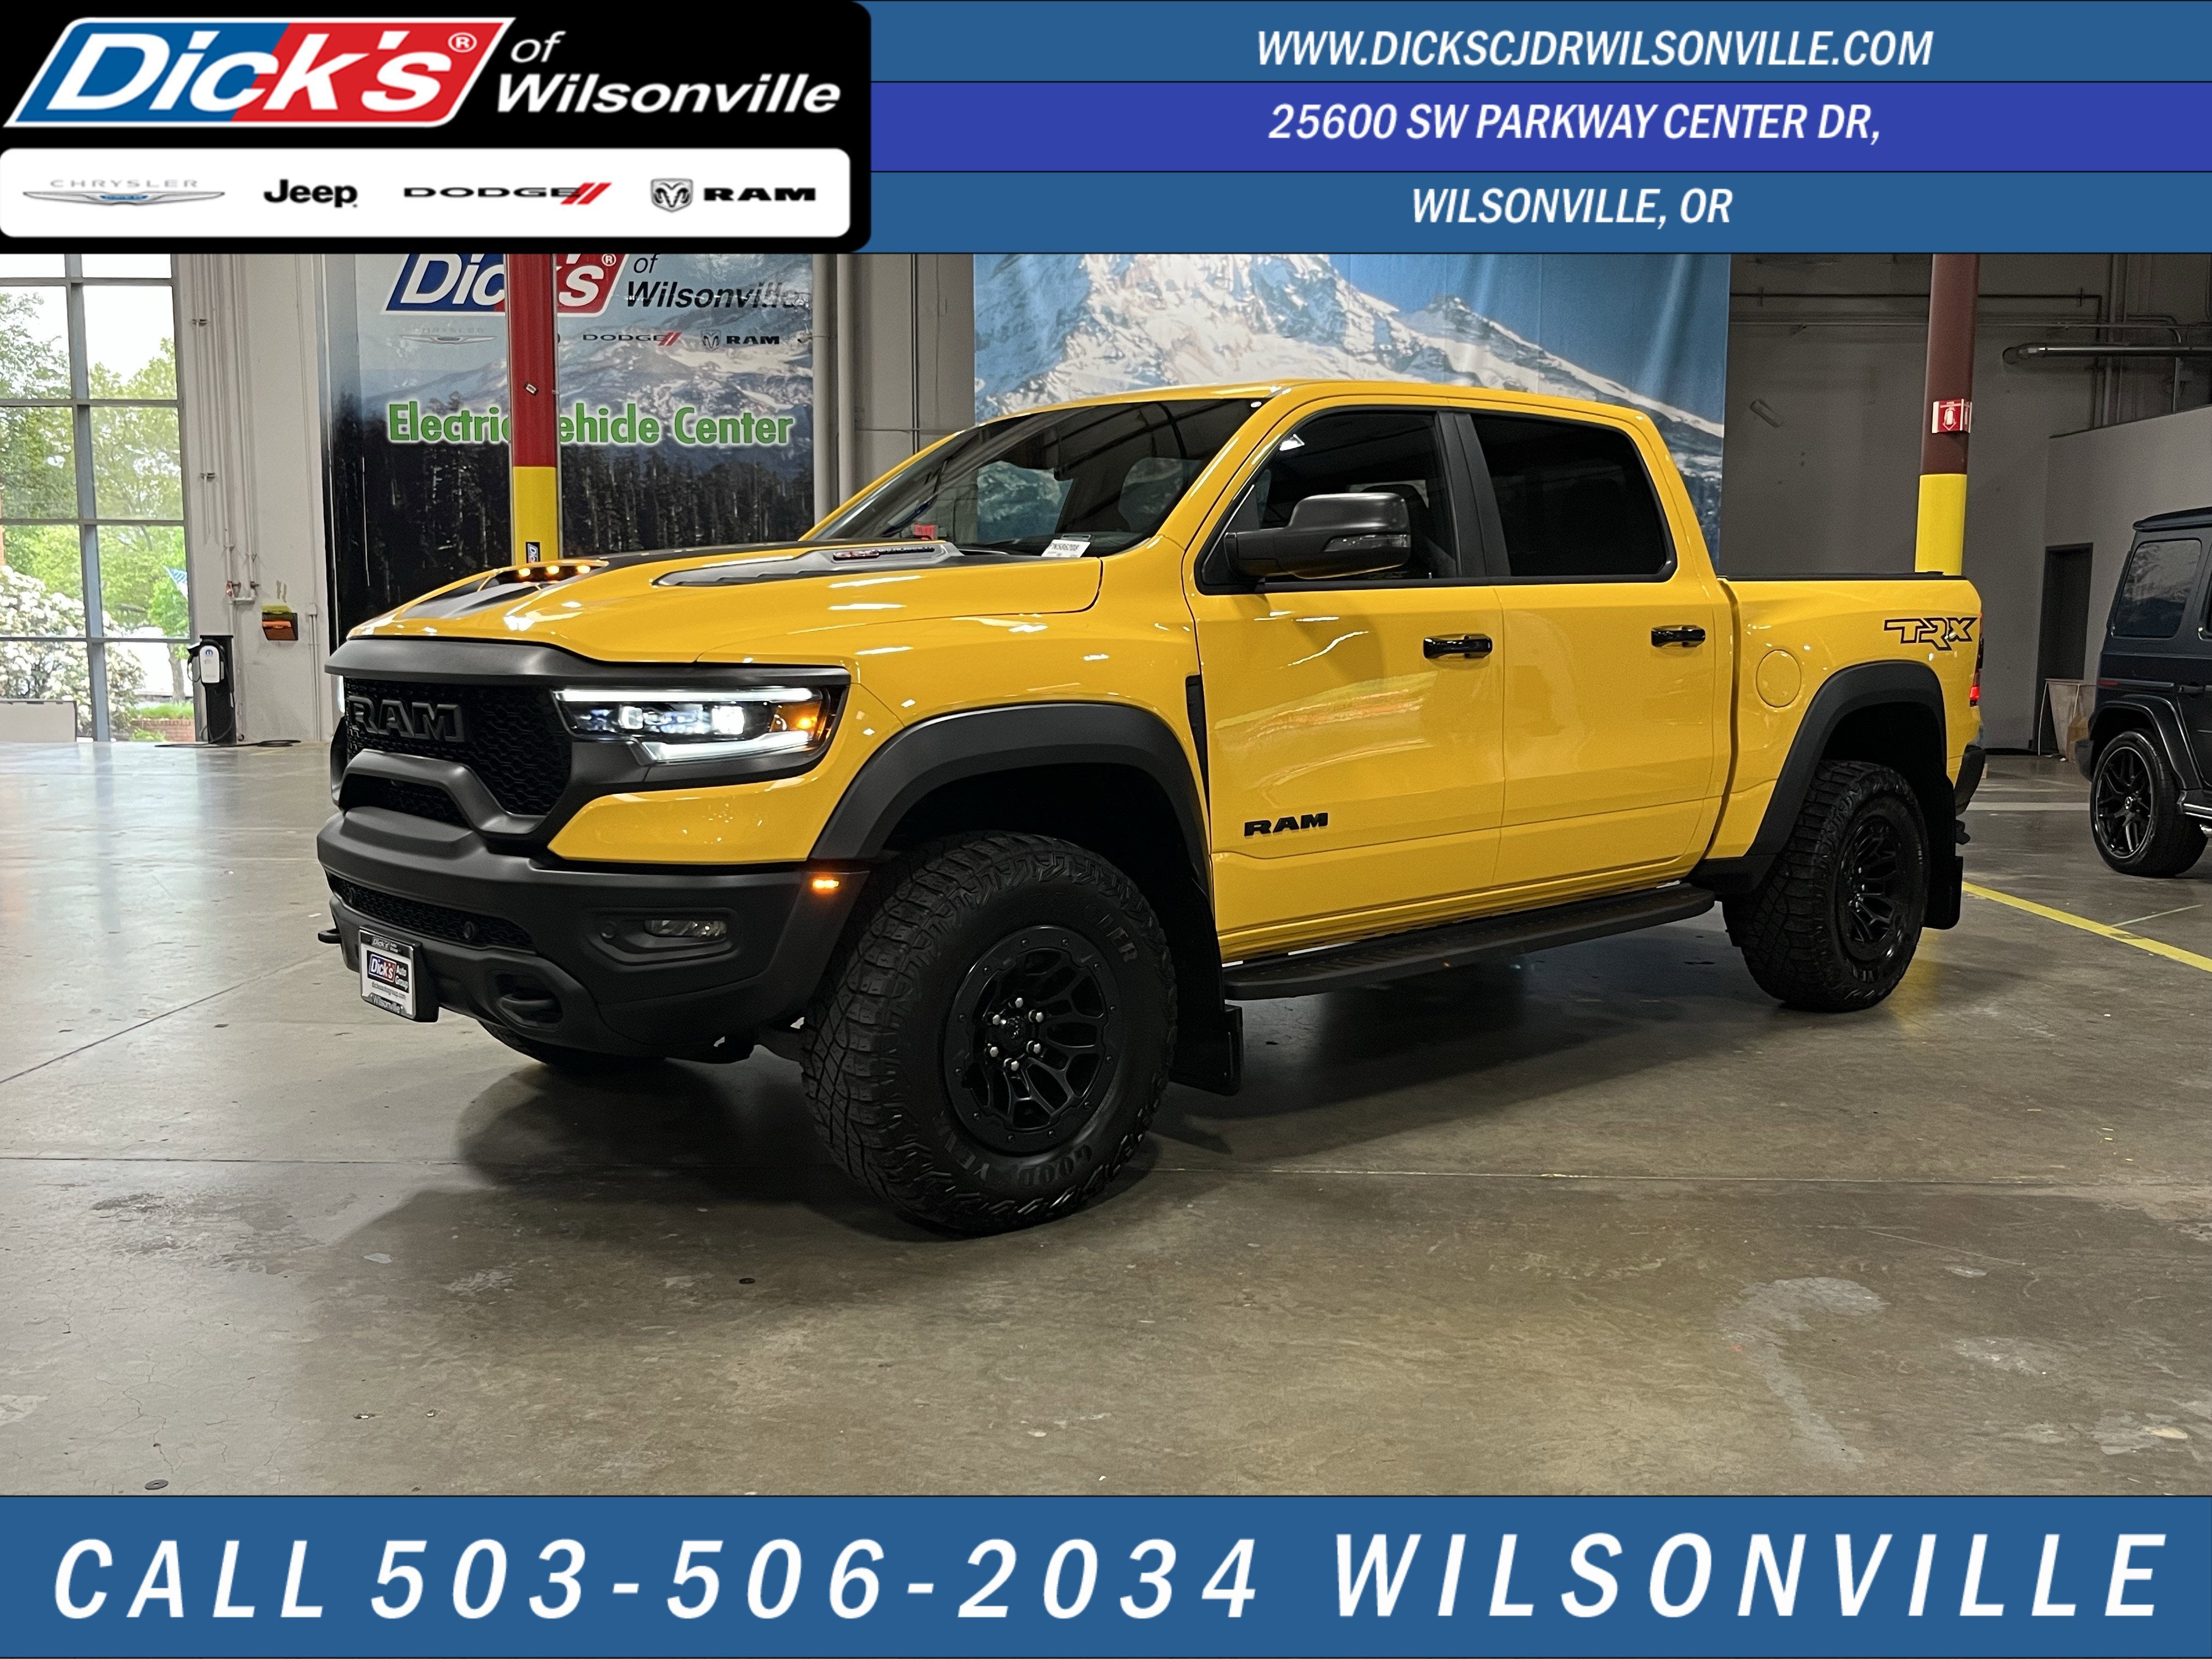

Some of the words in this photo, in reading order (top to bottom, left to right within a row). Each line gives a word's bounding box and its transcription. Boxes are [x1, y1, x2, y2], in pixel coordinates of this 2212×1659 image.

[400, 254, 604, 306] Dic's
[633, 254, 659, 273] of
[726, 335, 780, 345] RAM
[559, 403, 659, 443] ehicle
[674, 407, 794, 444] Center
[1883, 617, 1978, 651] TRX
[347, 695, 465, 743] RAM
[1244, 812, 1328, 837] RAM
[371, 958, 393, 979] Dick's
